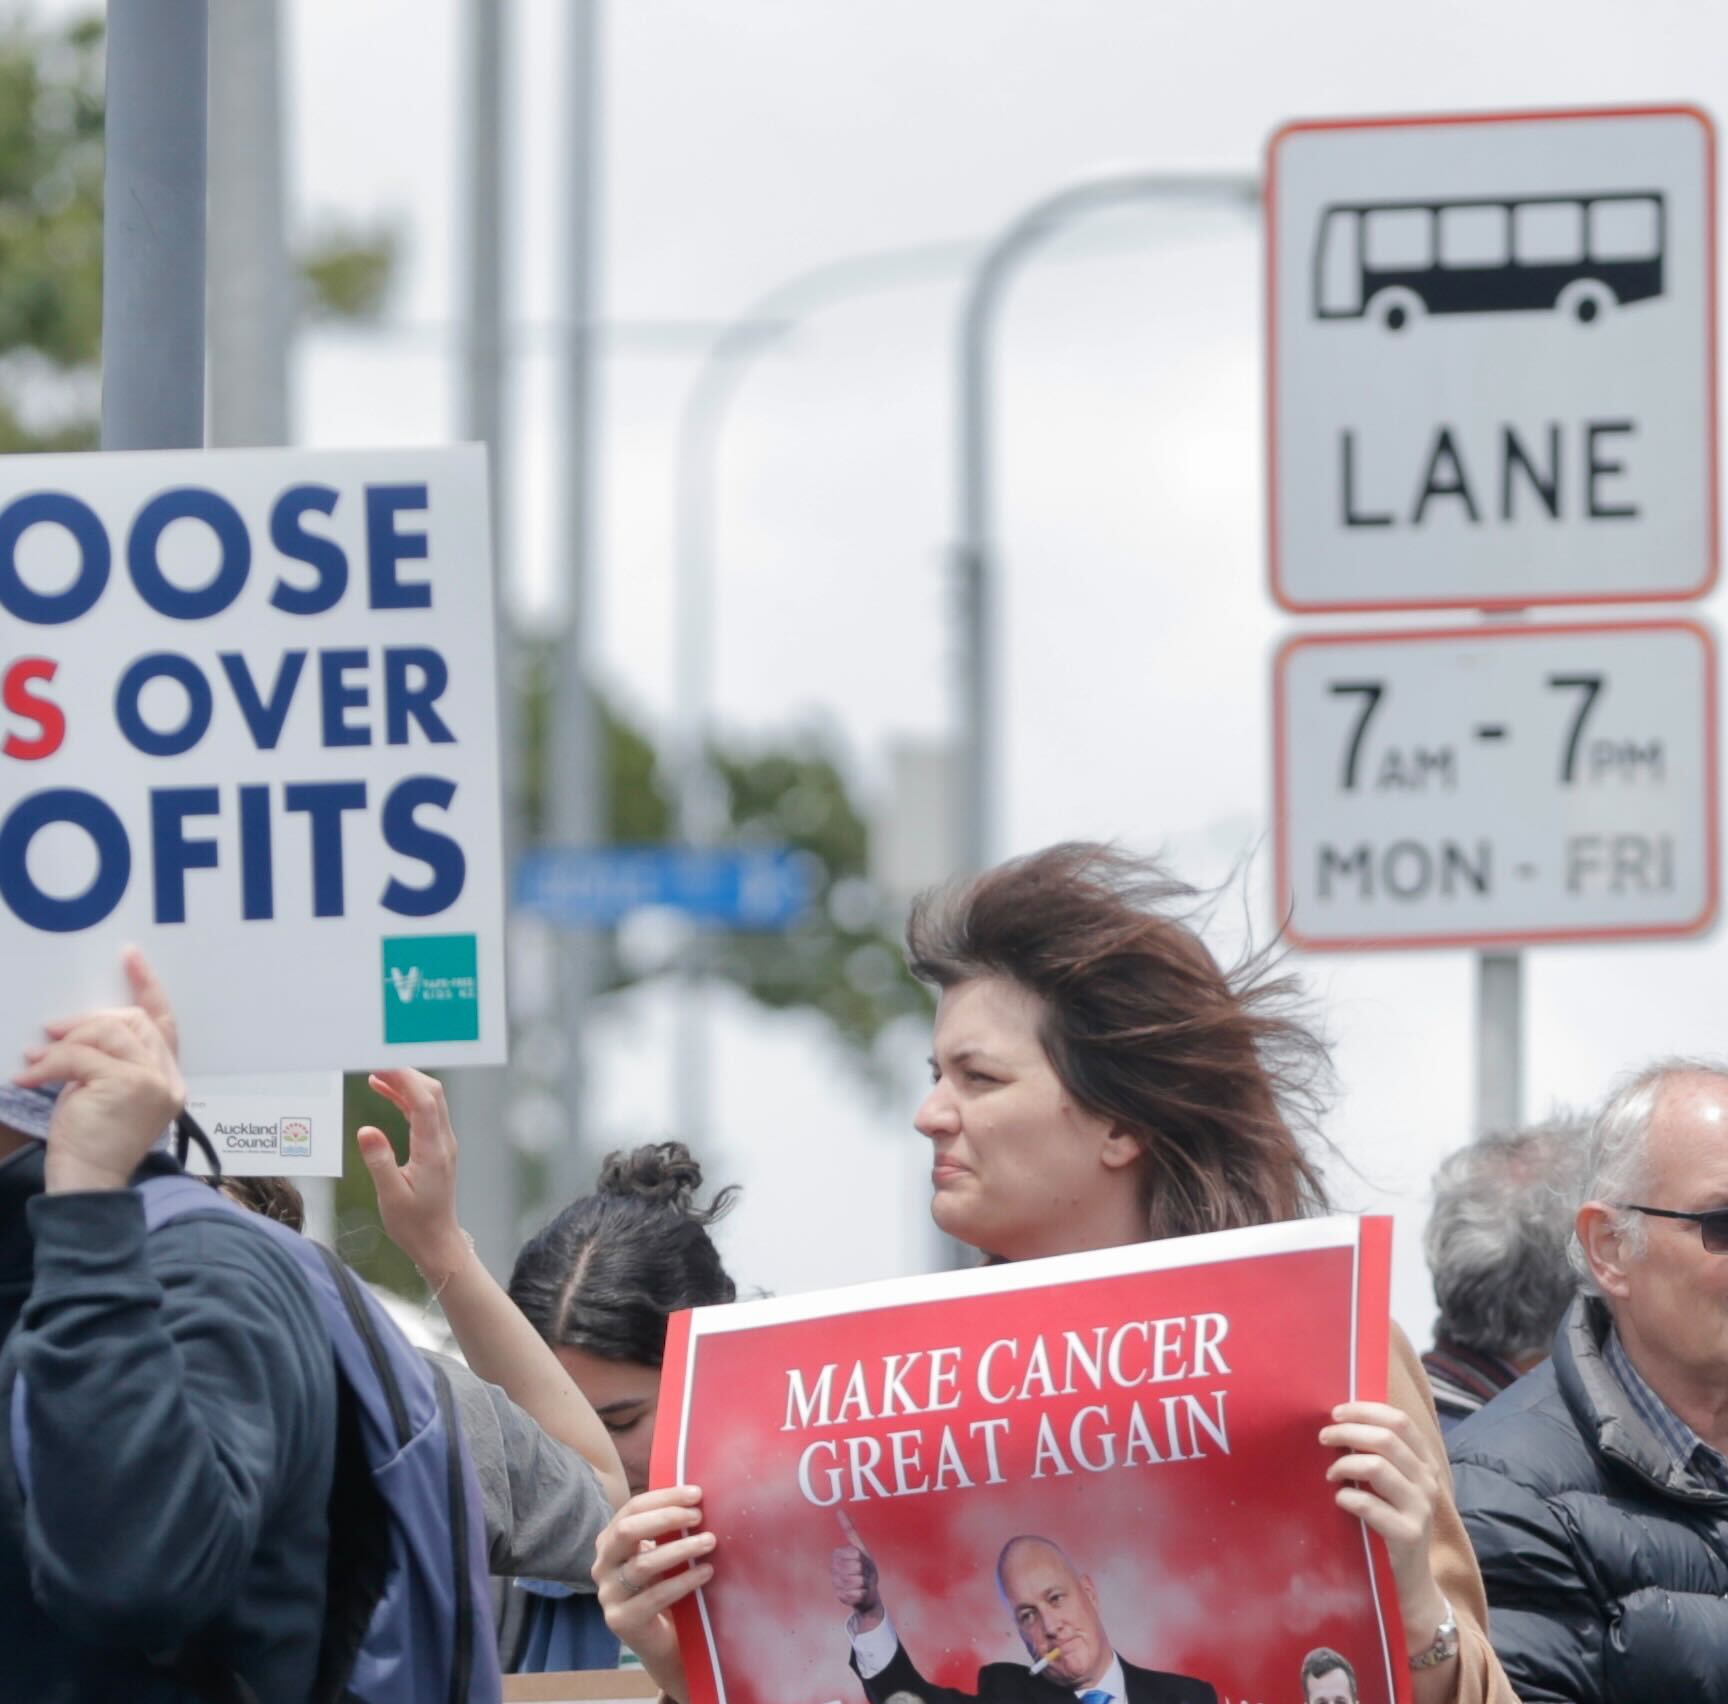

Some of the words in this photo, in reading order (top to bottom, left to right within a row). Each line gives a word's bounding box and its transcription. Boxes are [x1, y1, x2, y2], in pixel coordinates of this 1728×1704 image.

[1338, 420, 1642, 527] LANE
[114, 646, 457, 757] OVER
[1317, 839, 1491, 901] MON
[1564, 834, 1676, 896] FRI
[214, 1122, 277, 1135] Auckland
[226, 1135, 277, 1149] Council
[780, 1346, 962, 1432] MAKE
[976, 1312, 1232, 1403] CANCER
[797, 1419, 1010, 1507] GREAT
[1031, 1391, 1232, 1479] AGAIN
